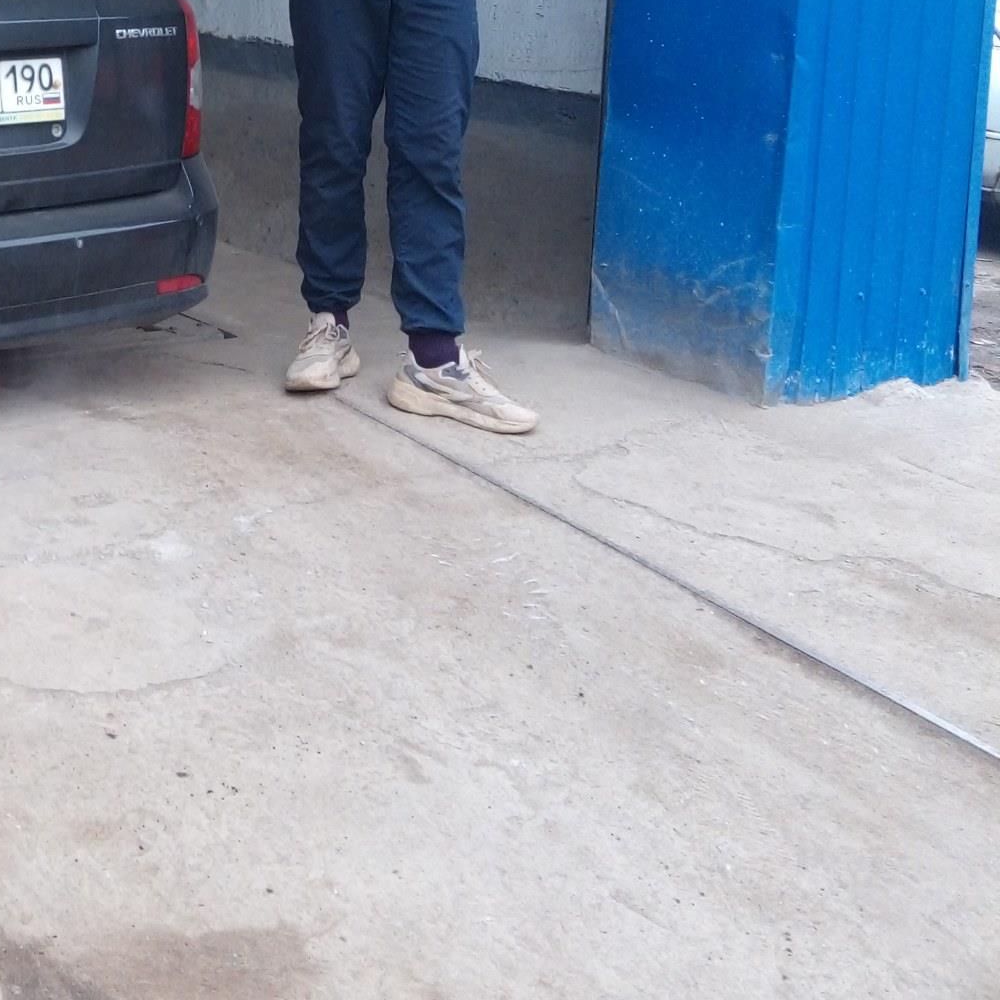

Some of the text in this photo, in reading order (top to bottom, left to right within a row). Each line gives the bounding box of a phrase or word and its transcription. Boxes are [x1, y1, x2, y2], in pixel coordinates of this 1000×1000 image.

[115, 26, 178, 40] CHEVROLET
[5, 63, 54, 94] 190
[16, 94, 42, 106] RUS
